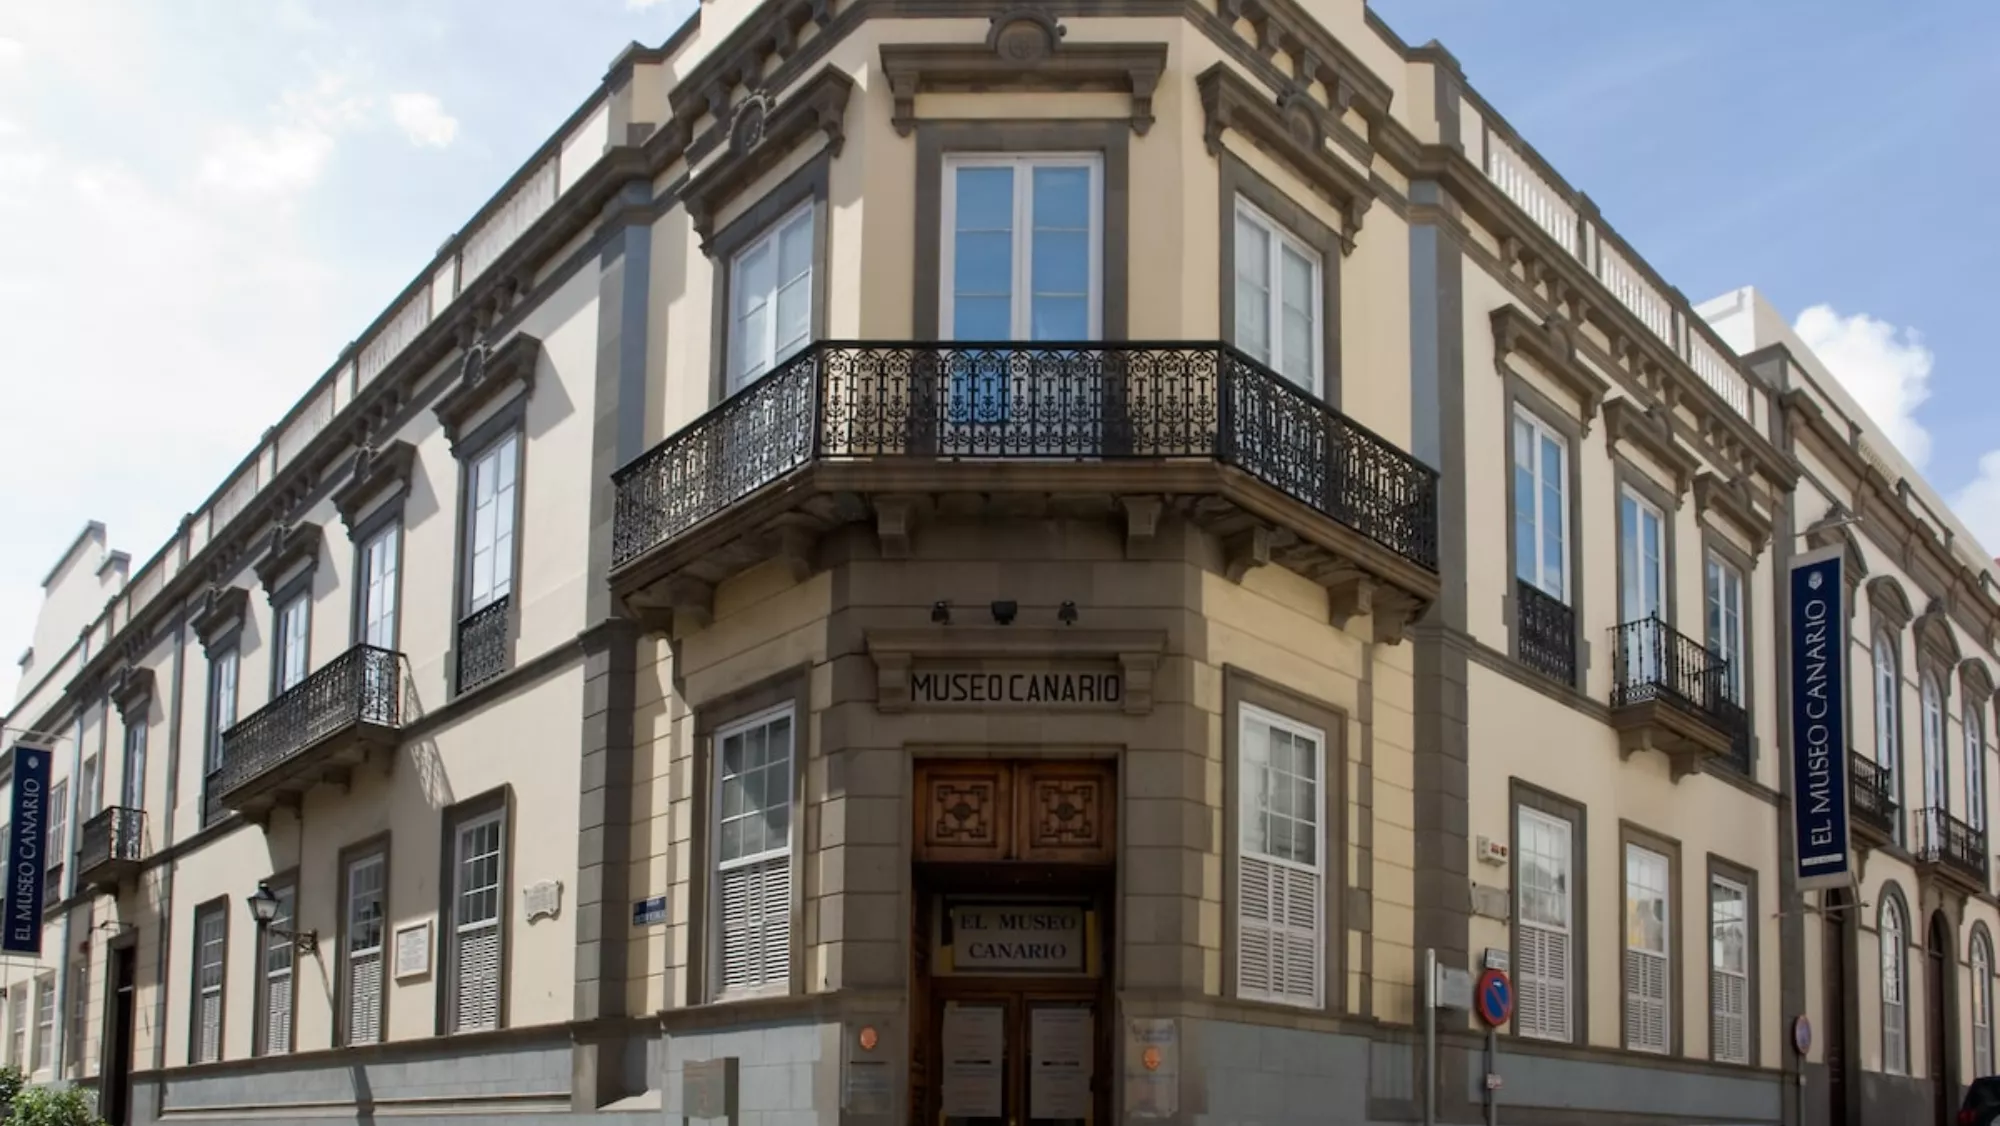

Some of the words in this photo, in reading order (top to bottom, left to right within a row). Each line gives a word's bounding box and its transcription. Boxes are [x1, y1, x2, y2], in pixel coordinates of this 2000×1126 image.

[1805, 599, 1827, 720] CANARIO
[911, 673, 1002, 702] MUSEO
[1009, 673, 1120, 702] CANARIO
[1807, 723, 1831, 815] MUSEO
[21, 778, 40, 859] CANARIO
[1811, 818, 1832, 846] EL
[17, 862, 35, 920] MUSEO
[16, 925, 30, 940] EL
[960, 914, 988, 930] EL
[999, 914, 1076, 931] MUSEO
[969, 942, 1067, 960] CANARIO
